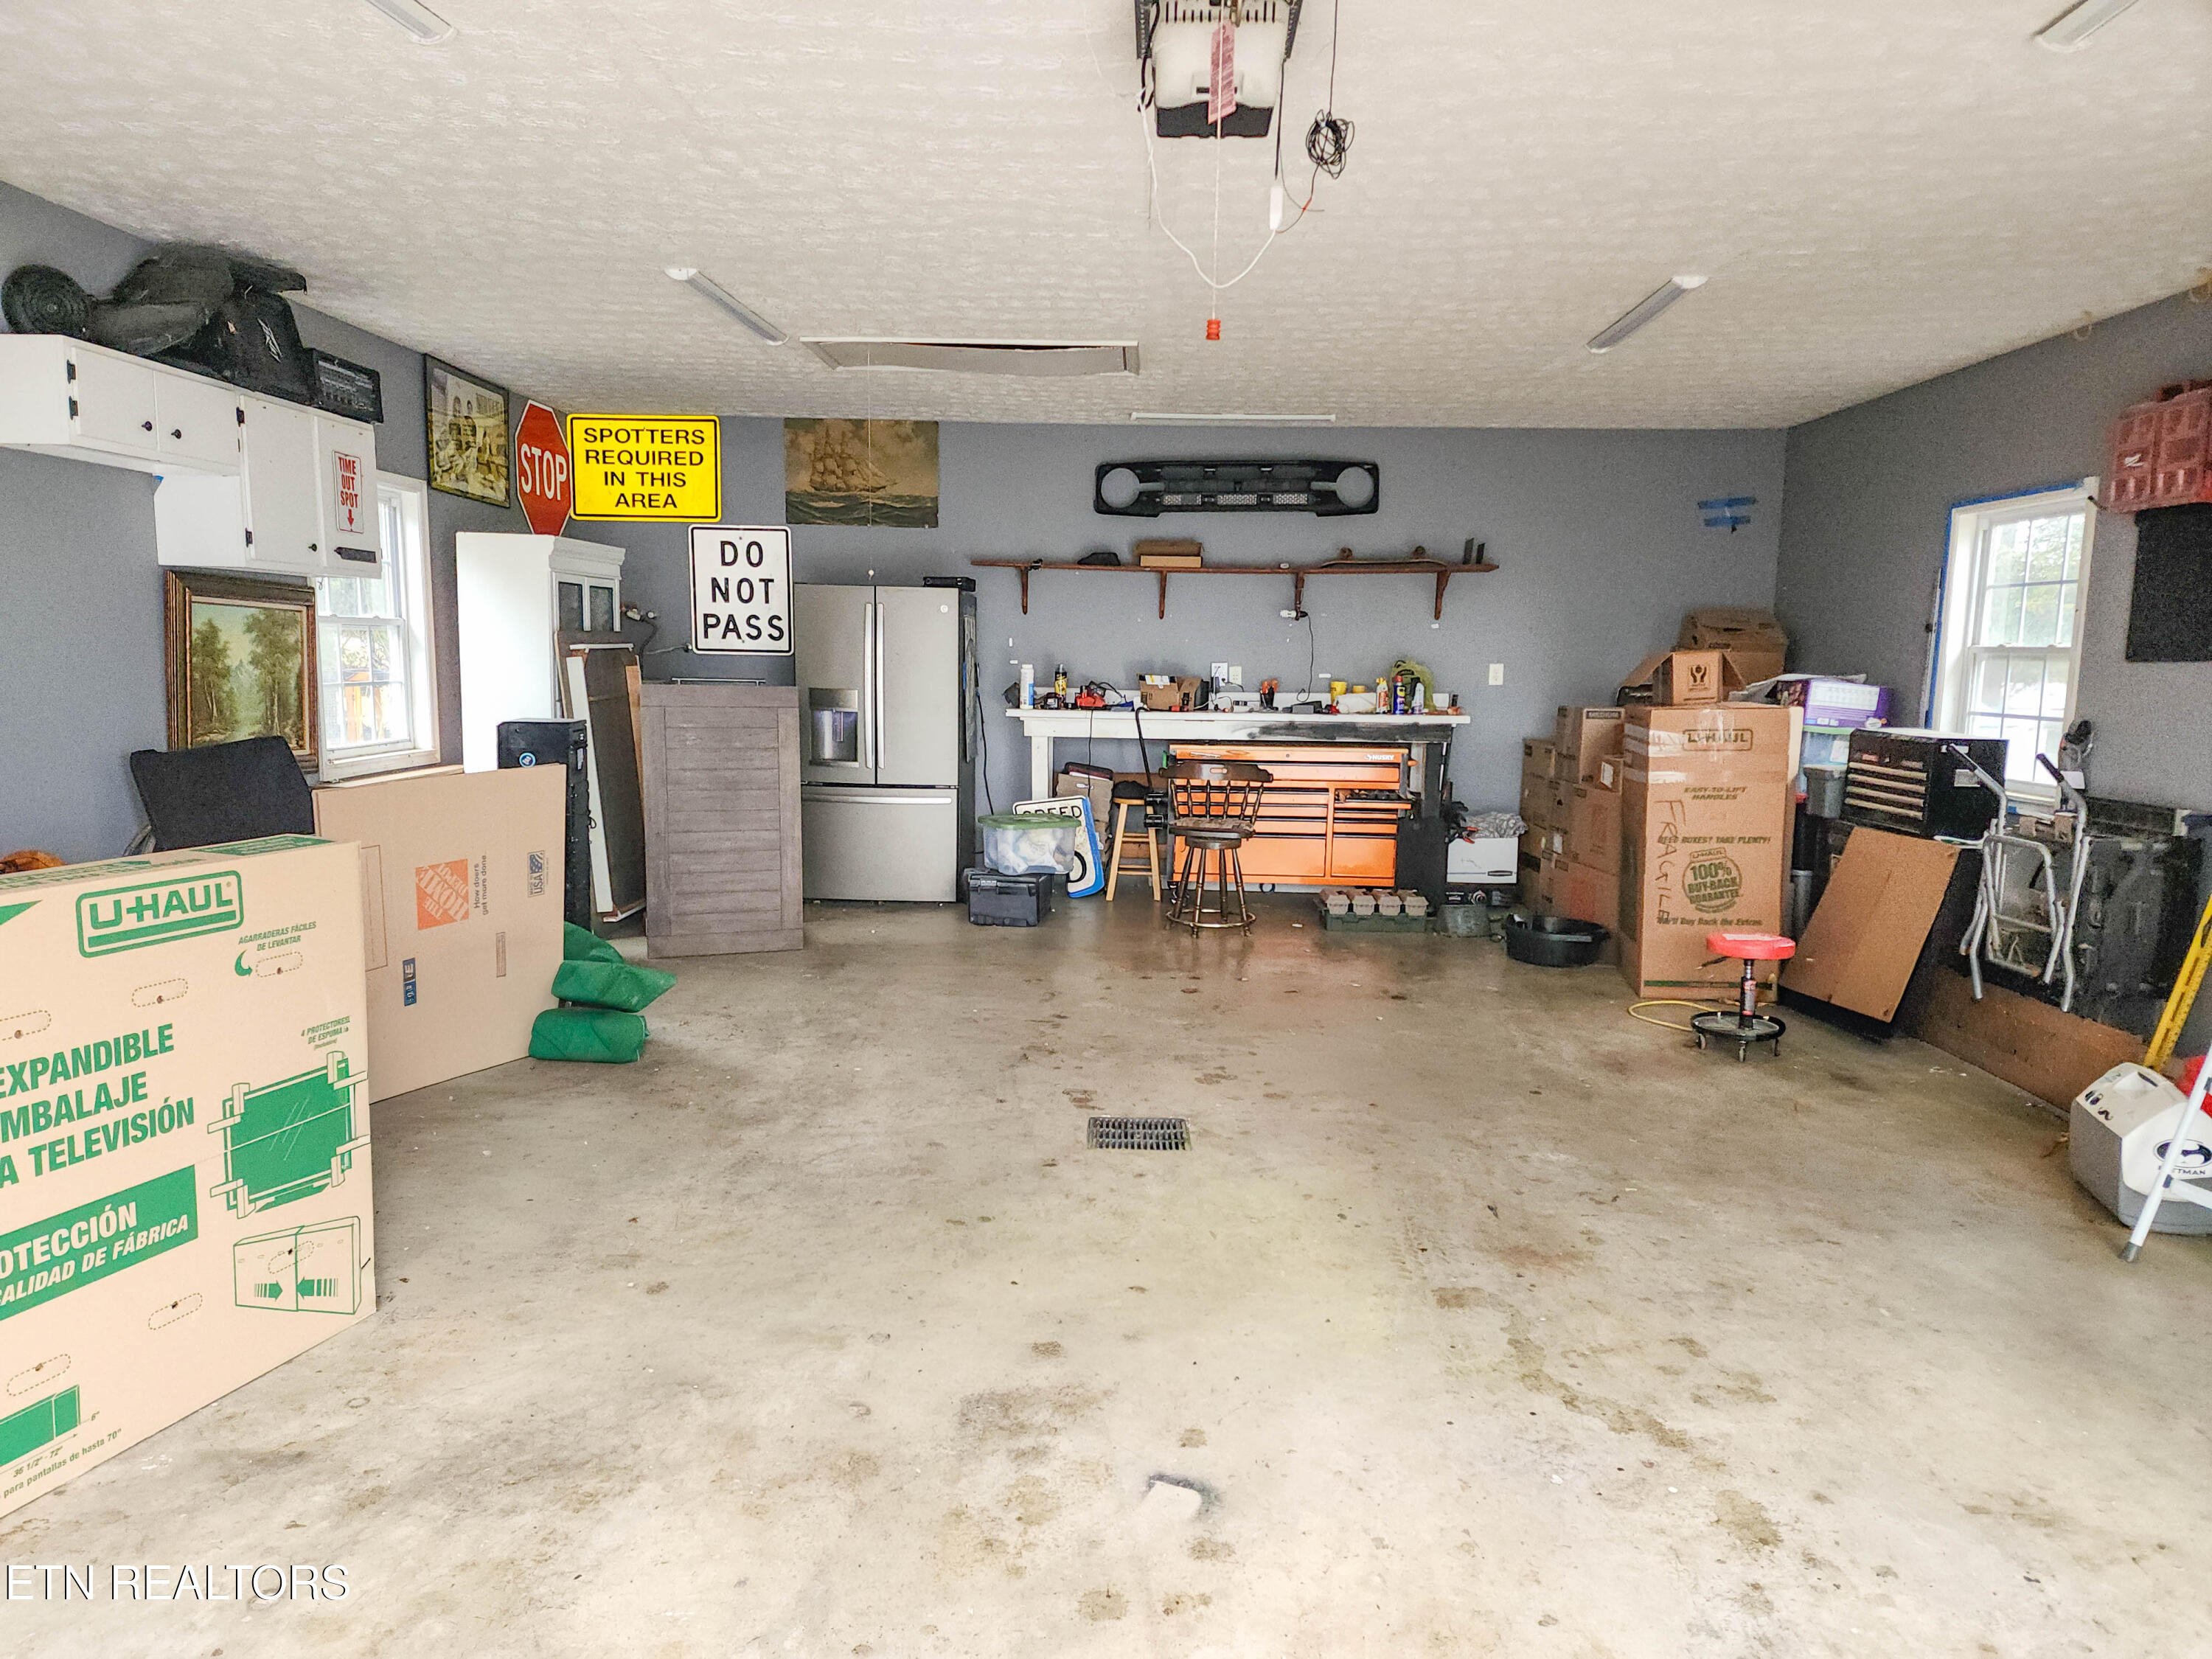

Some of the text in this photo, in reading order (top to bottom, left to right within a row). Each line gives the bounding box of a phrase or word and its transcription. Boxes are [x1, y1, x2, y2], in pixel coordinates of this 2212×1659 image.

[584, 428, 705, 445] SPOTTERS
[338, 456, 356, 475] TIME
[585, 450, 703, 466] REQUIRED
[520, 443, 567, 500] STOP
[604, 472, 686, 487] IN THIS
[341, 474, 355, 491] OUT
[341, 490, 358, 508] SPOT
[615, 493, 678, 509] AREA
[720, 540, 764, 568] DO
[711, 578, 775, 604] NOT
[703, 613, 785, 641] PASS
[1655, 801, 1686, 921] FRAGILE
[1689, 861, 1732, 880] 100%
[533, 873, 543, 894] USA
[1688, 877, 1739, 893] BUY-BACK
[89, 883, 233, 930] U-HAUL
[238, 921, 316, 945] AGARRADERAS FÁCILES
[257, 935, 301, 951] DE LEVANTAR
[308, 1035, 316, 1044] DE
[28, 1096, 194, 1177] TELEVISIÓN
[0, 1214, 188, 1307] ALIDAD DE FÁBRICA
[4, 1482, 24, 1498] para
[27, 1460, 67, 1486] pantallas
[69, 1453, 79, 1462] de
[82, 1439, 105, 1455] hasta
[13, 1466, 24, 1478] 36
